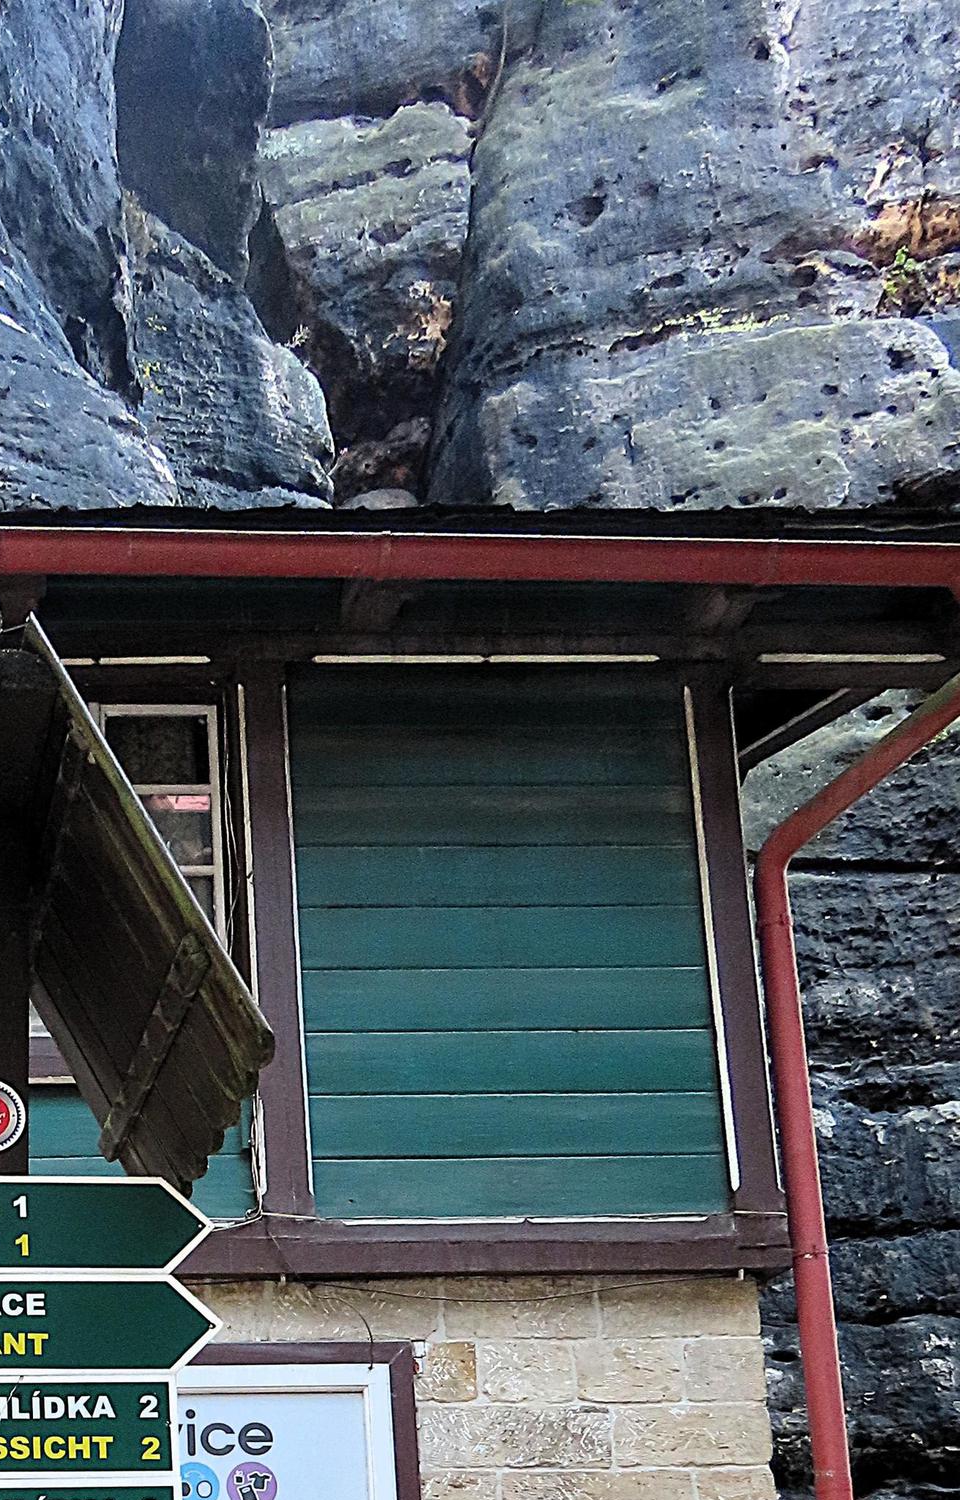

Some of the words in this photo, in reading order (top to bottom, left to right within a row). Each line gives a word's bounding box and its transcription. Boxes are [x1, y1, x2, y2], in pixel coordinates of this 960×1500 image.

[13, 1195, 27, 1217] 1
[15, 1234, 29, 1256] 1
[139, 1395, 159, 1419] 2
[178, 1408, 274, 1456] ice
[141, 1437, 161, 1460] 2
